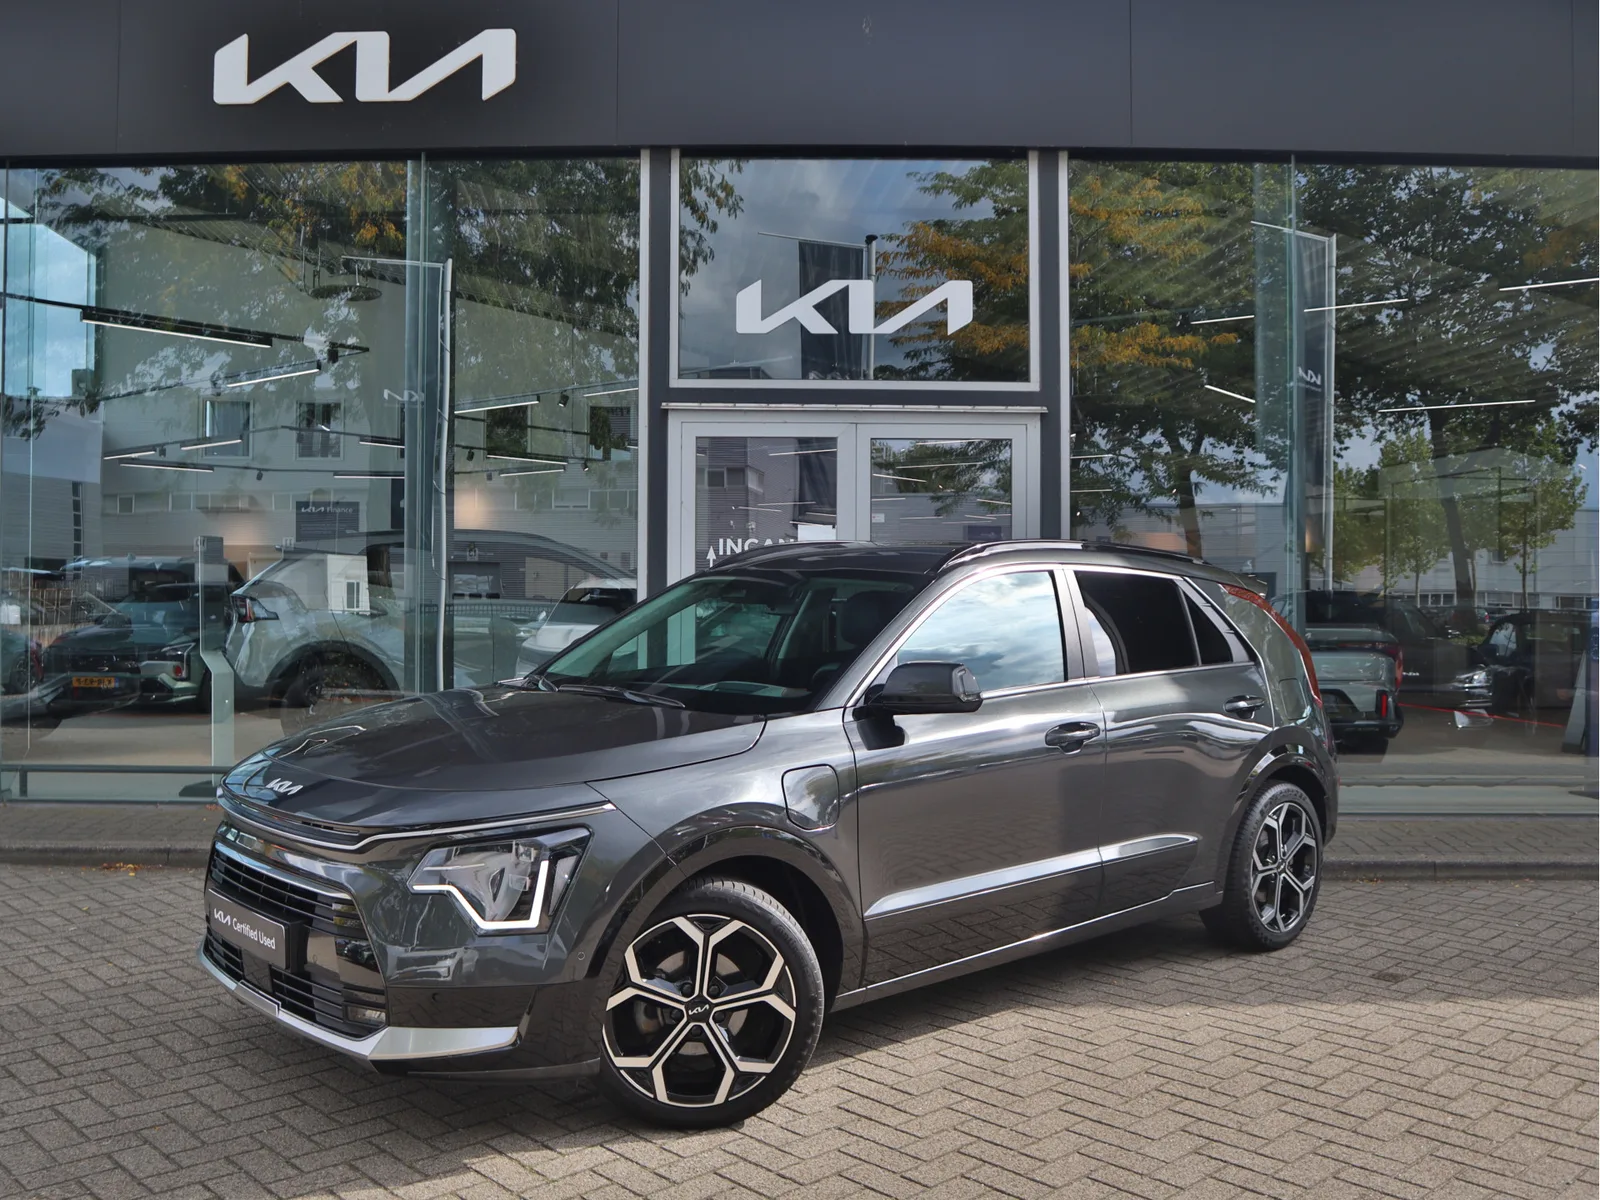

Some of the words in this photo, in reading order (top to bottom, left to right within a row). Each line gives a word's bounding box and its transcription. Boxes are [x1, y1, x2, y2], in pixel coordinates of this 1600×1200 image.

[213, 28, 516, 105] KIA
[736, 279, 974, 336] KIA
[265, 777, 303, 795] KIA
[213, 907, 231, 927] KIA
[232, 917, 258, 942] Certified
[258, 930, 276, 950] Used
[688, 1004, 709, 1015] KIA
